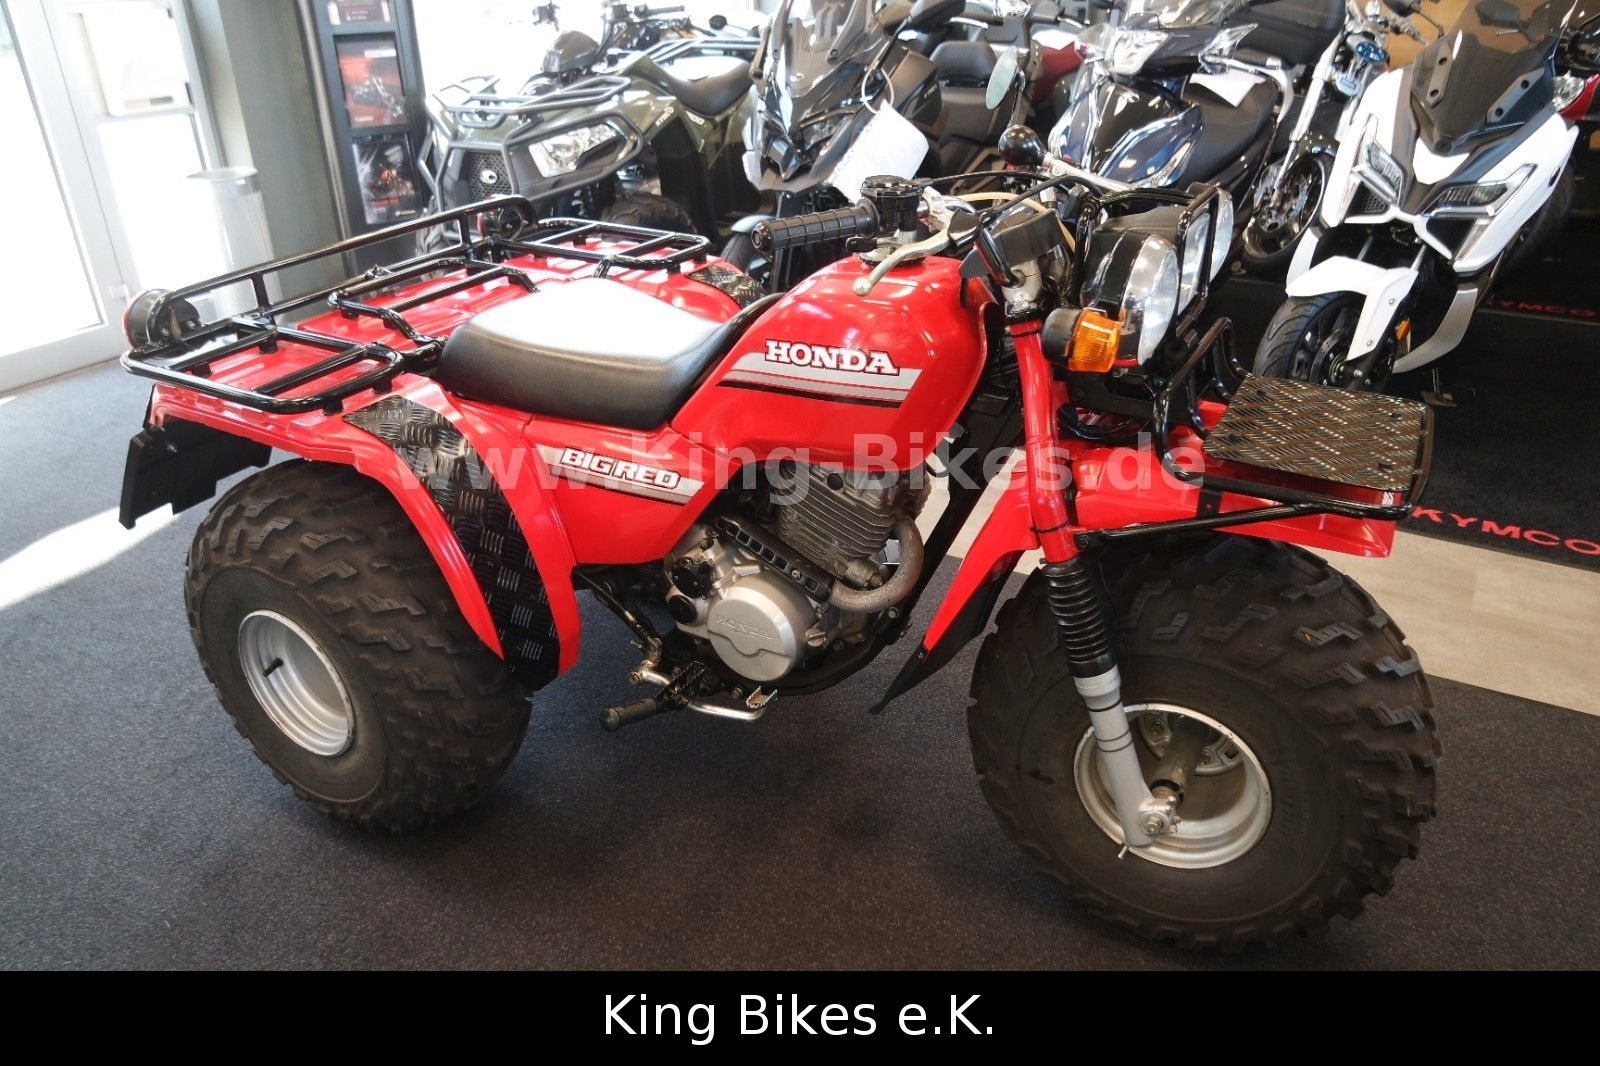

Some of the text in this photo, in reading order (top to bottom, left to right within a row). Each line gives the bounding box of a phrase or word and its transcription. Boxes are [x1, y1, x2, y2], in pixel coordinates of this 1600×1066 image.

[765, 338, 900, 376] HONDA
[560, 446, 682, 490] BIG RED
[1411, 505, 1600, 555] KYMCO
